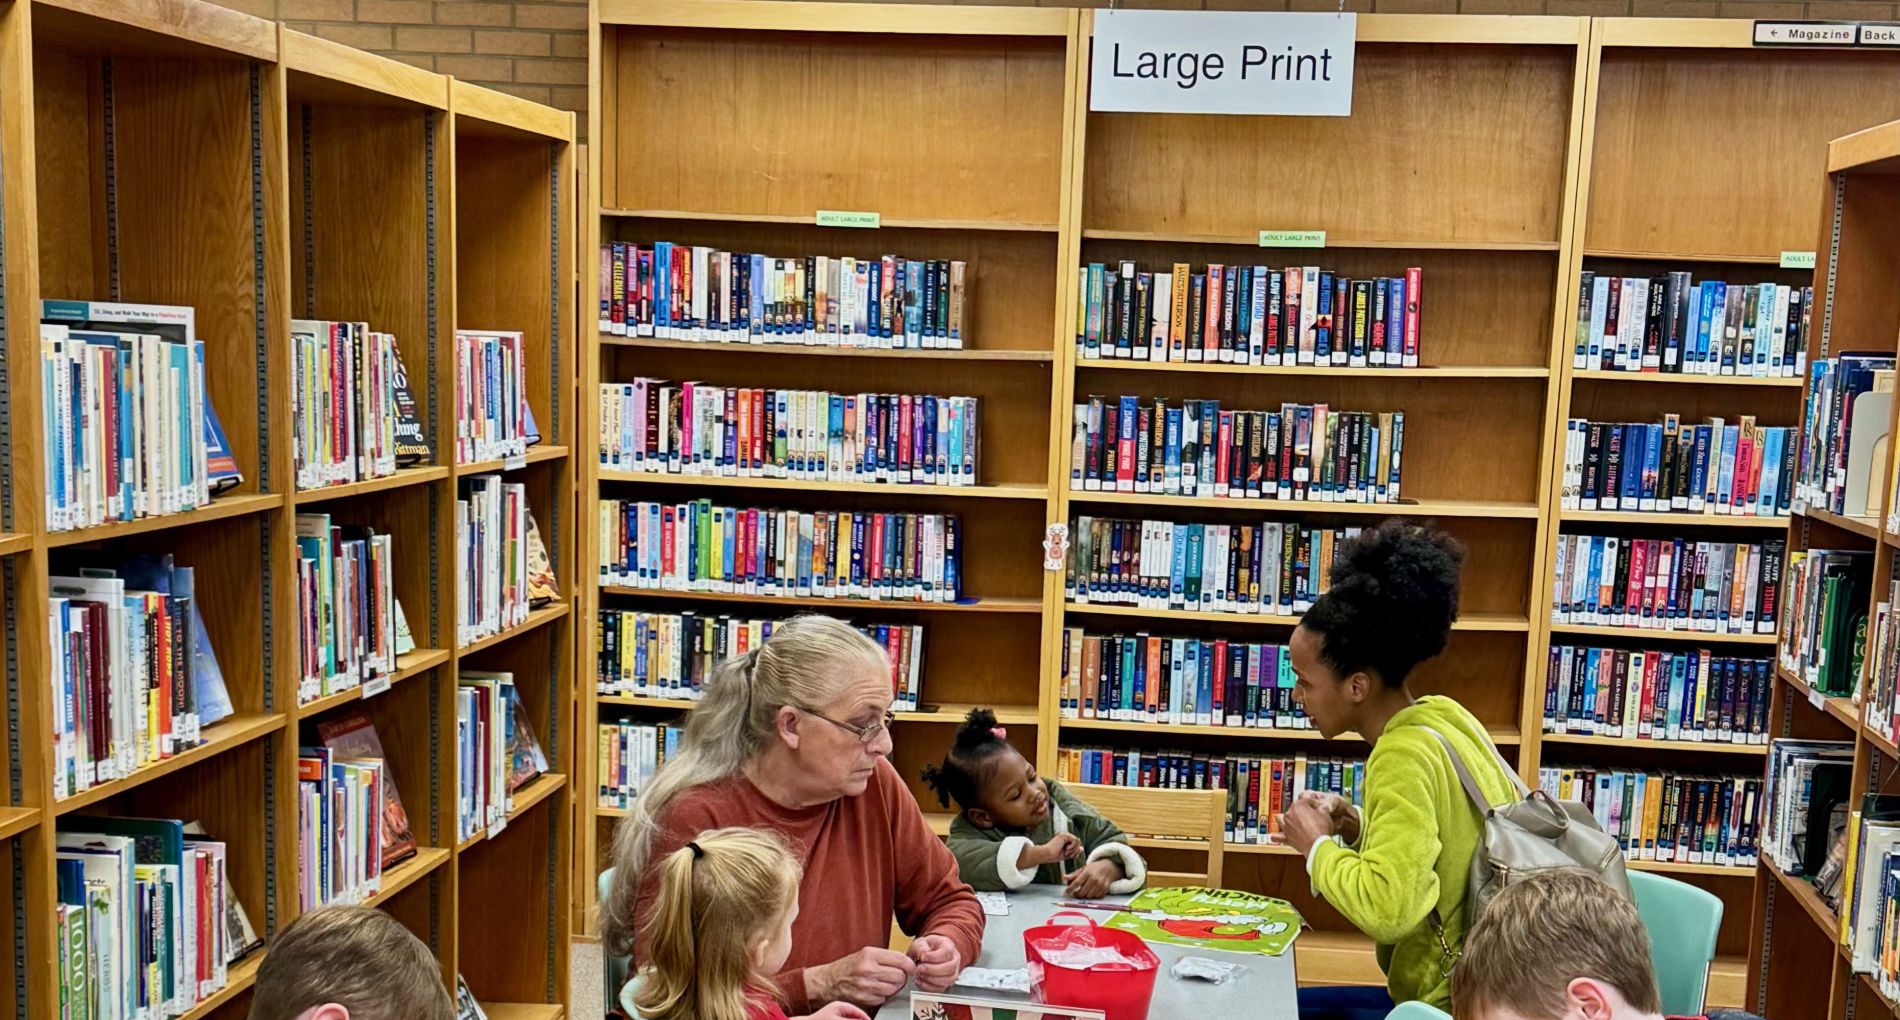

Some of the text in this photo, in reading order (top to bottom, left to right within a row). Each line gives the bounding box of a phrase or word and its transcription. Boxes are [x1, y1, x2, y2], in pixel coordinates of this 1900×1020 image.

[1788, 29, 1850, 41] Magazine
[1865, 30, 1896, 41] Back
[1113, 42, 1332, 89] Large Print
[613, 261, 623, 300] KELLERMAN
[1255, 281, 1265, 300] BEACH
[1175, 289, 1184, 327] PATTERSON
[1224, 297, 1233, 330] PATTERSON
[1373, 322, 1384, 346] GONE
[1827, 390, 1841, 476] AMERICAN CINEMA
[947, 534, 955, 549] CRASH
[1763, 554, 1772, 583] TUROW
[1771, 557, 1780, 581] SCOTT
[176, 629, 182, 642] TO
[72, 920, 84, 992] 1000
[102, 953, 110, 992] HERBS
